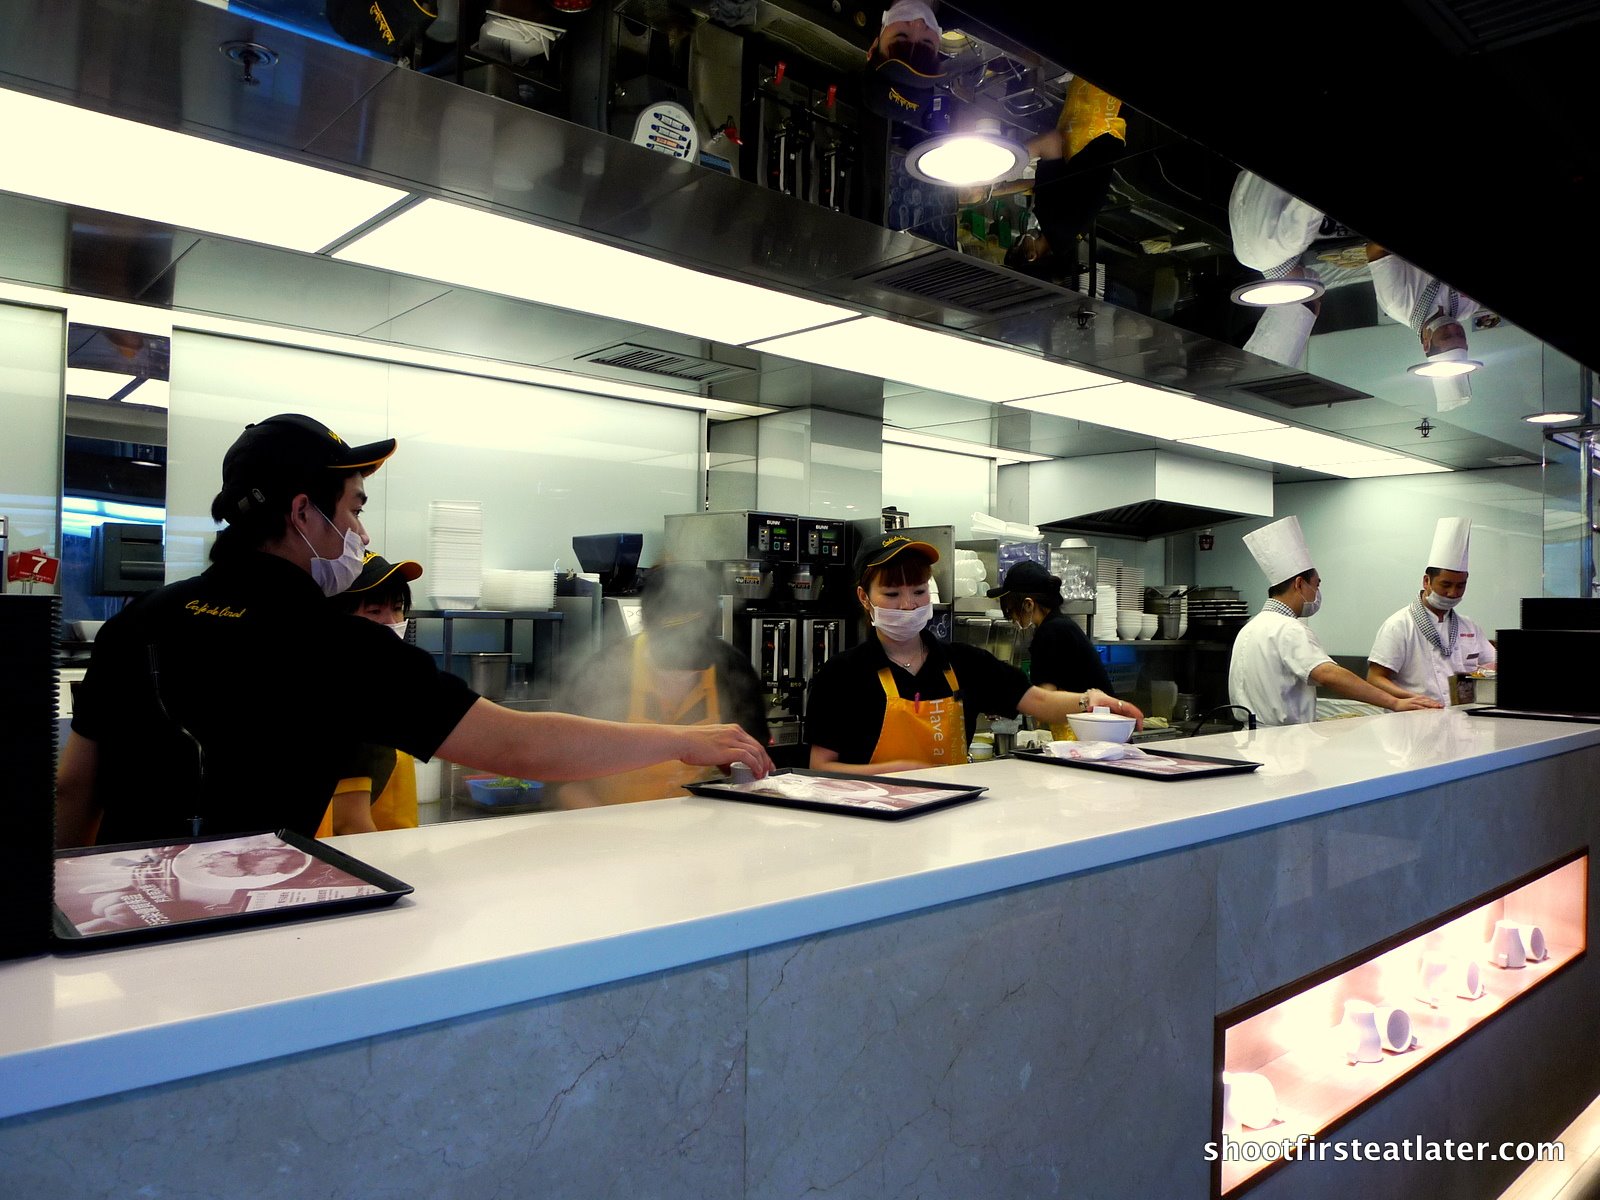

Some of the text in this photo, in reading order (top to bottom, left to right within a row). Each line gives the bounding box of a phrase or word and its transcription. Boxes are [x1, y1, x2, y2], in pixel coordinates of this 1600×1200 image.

[32, 556, 47, 574] 7
[929, 699, 945, 756] Have a
